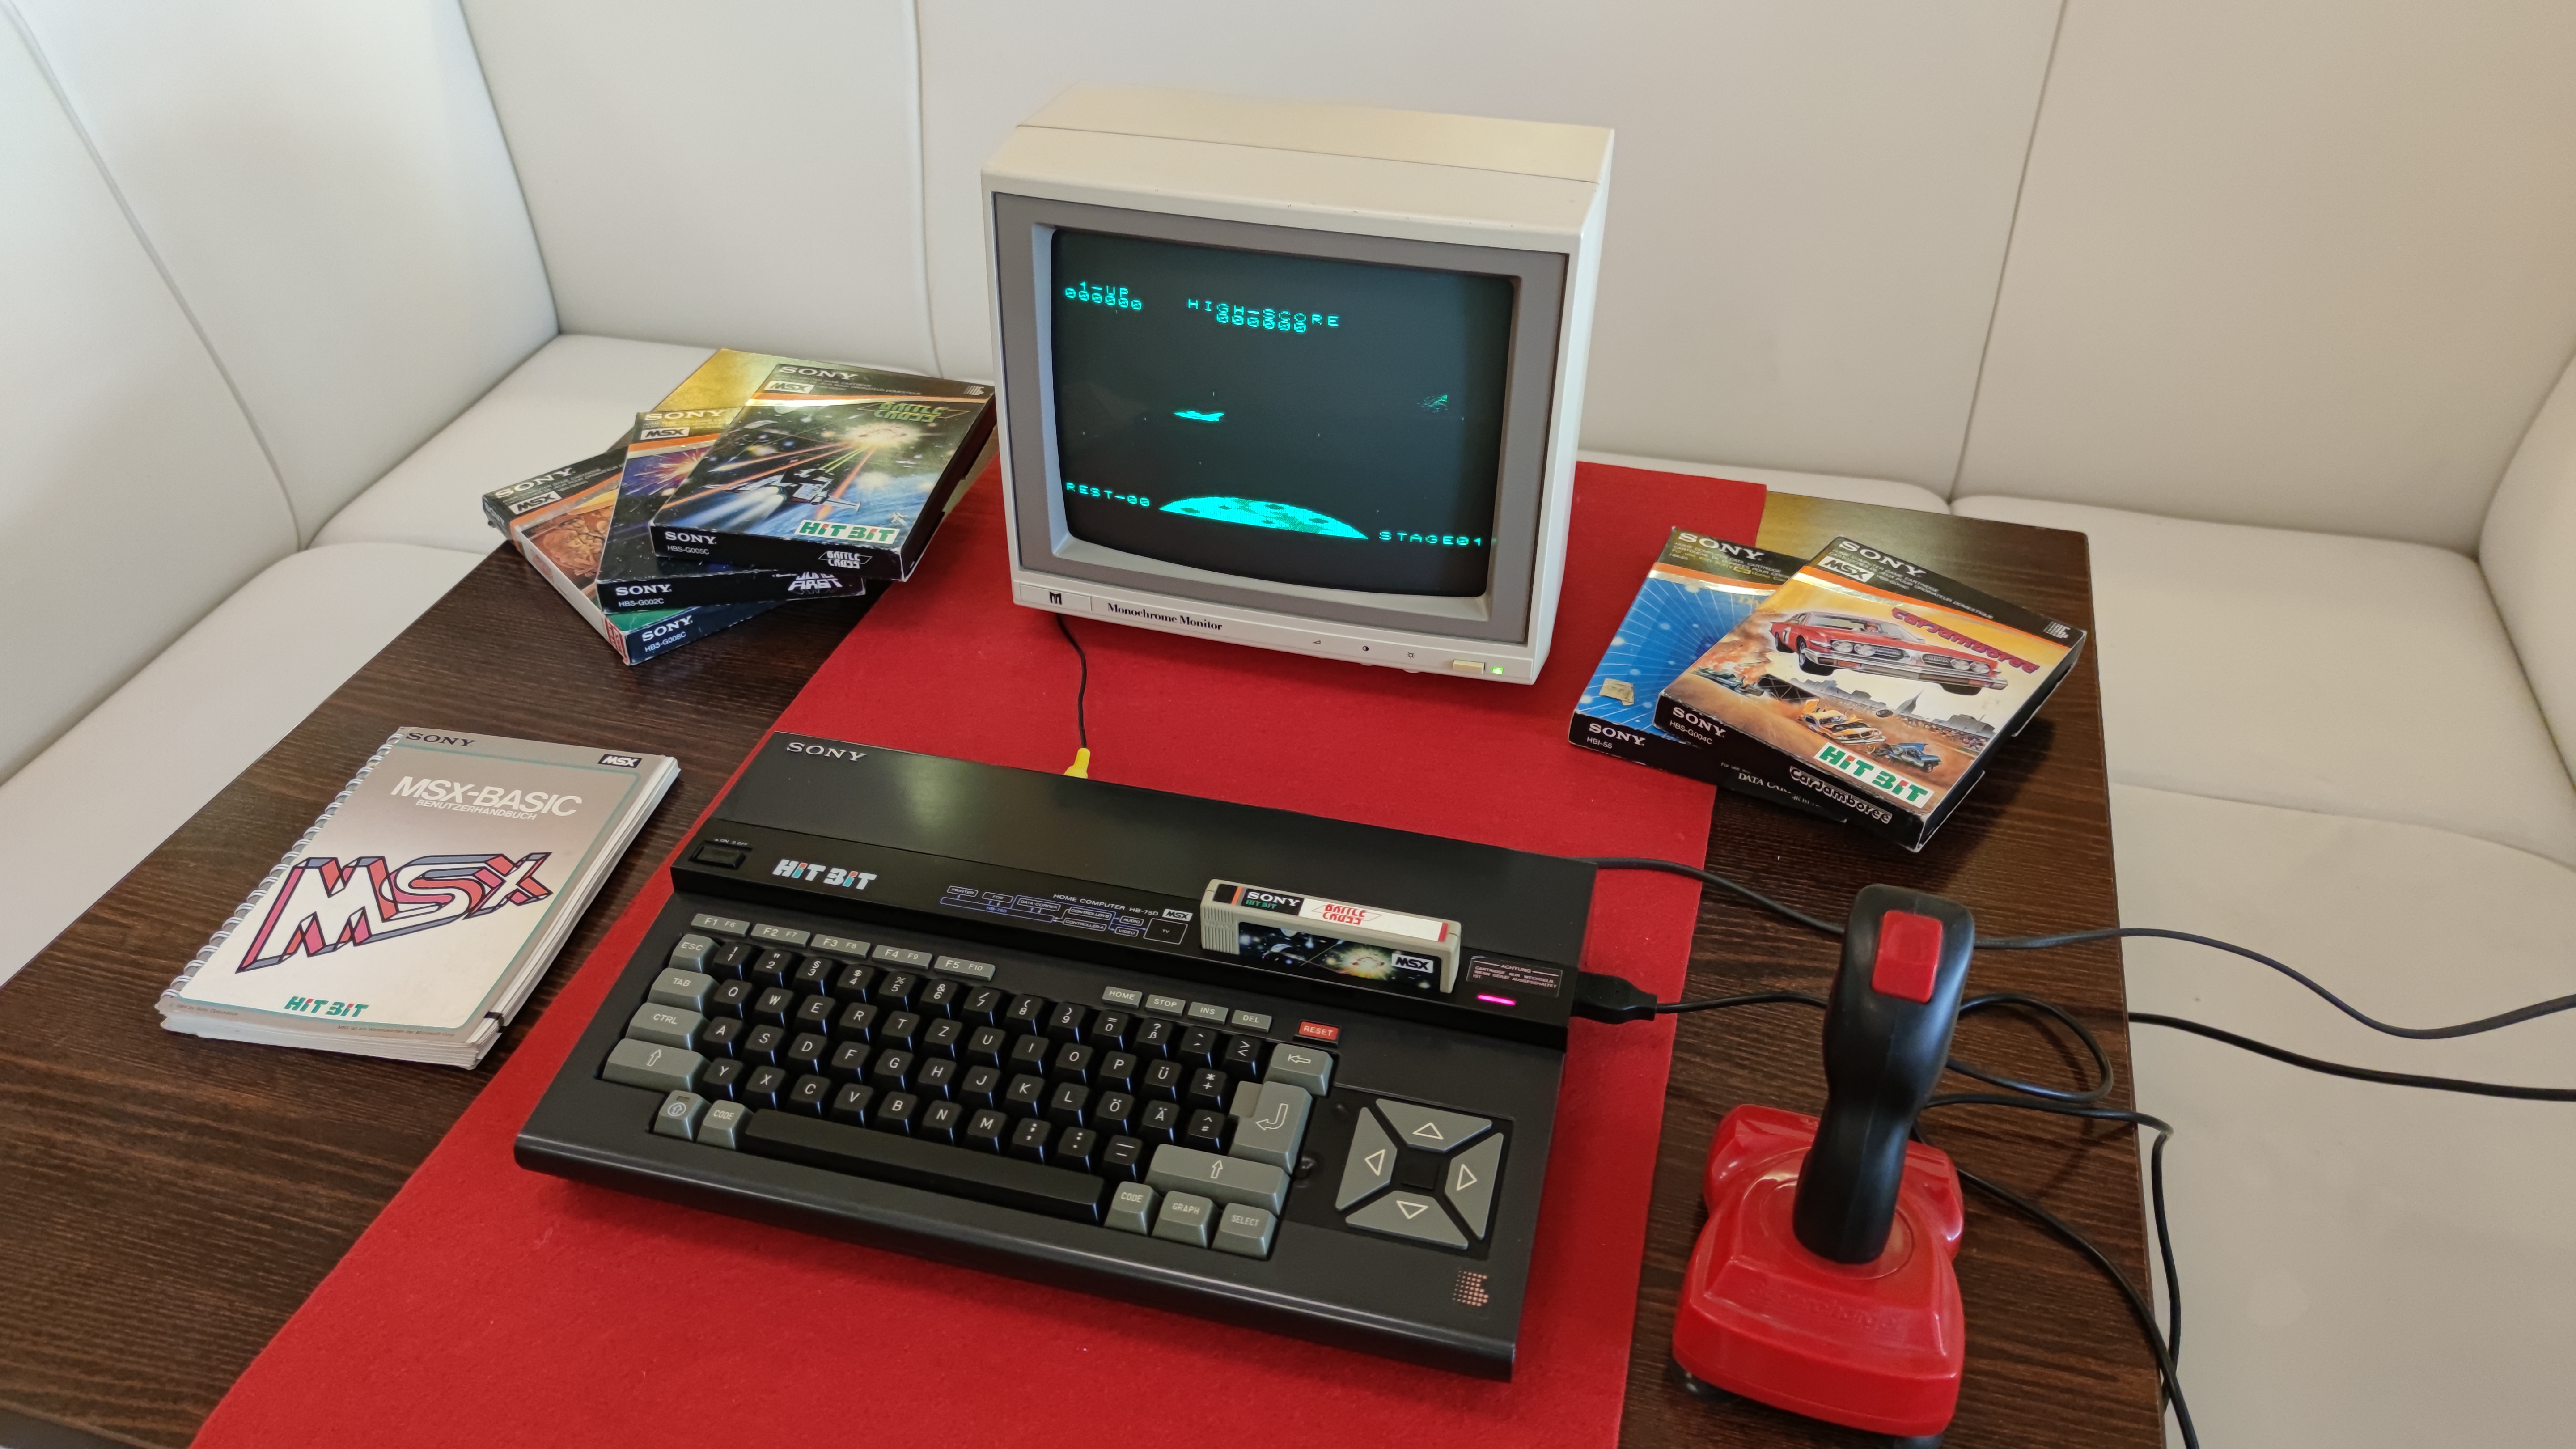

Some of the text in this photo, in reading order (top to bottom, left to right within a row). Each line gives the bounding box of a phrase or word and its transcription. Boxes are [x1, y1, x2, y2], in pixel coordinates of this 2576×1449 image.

[1080, 281, 1128, 297] 1-UP
[1065, 288, 1142, 310] 000000
[1188, 298, 1339, 327] HIGH-SCORE
[1216, 313, 1306, 333] 000000
[779, 366, 858, 380] SONY
[769, 382, 810, 392] MSX
[645, 410, 726, 420] SONY
[645, 429, 685, 438] MSX
[495, 467, 572, 499] SONY
[1066, 482, 1149, 507] REST-00
[517, 494, 556, 512] MSX
[665, 531, 716, 544] SONY
[1379, 531, 1481, 546] STAGE01
[667, 545, 709, 555] HBS-G005C
[1678, 533, 1764, 561] SONY
[1839, 541, 1926, 576] SONY
[1747, 562, 1781, 573] CARTRIDGE
[1824, 560, 1868, 580] MSX
[615, 584, 672, 596] SONY
[788, 578, 843, 591] FIRST
[1904, 576, 1939, 593] CARTRIDGE
[1878, 570, 1895, 579] JEUX
[1895, 576, 1913, 587] POUR
[1914, 584, 1952, 603] ORDINATEUR
[1953, 600, 1993, 620] DOMESTIQUE
[618, 598, 664, 607] HBS-G002C
[1108, 603, 1222, 631] Monochrome Monitor
[642, 615, 693, 642] SONY
[644, 631, 686, 653] HBS-G008C
[1673, 707, 1726, 738] SONY
[1589, 723, 1646, 746] SONY
[1670, 720, 1712, 745] HBS-G004C
[406, 732, 477, 747] SONY
[786, 742, 866, 761] SONY
[602, 756, 637, 767] MSX
[1738, 773, 1764, 786] DATA
[391, 776, 582, 817] MSX-BASIC
[1789, 766, 1892, 824] CarJamboree
[415, 799, 537, 820] BENUTZERHANDBUCH
[1247, 892, 1300, 906] SONY
[1053, 894, 1158, 916] HOME COMPUTER HB-75D
[235, 852, 553, 973] MSX
[1165, 911, 1190, 919] MSX
[704, 918, 717, 927] F1
[763, 928, 778, 936] F2
[681, 941, 703, 952] ESC
[823, 939, 838, 947] F3
[885, 949, 898, 958] F4
[945, 960, 983, 972] F5 F10
[1395, 957, 1429, 970] MSX
[1500, 964, 1531, 973] ACHTUNG
[1475, 966, 1505, 974] CARTRIDGE
[673, 978, 691, 987] TAB
[1512, 978, 1557, 988] AUSGESCHALTET
[728, 987, 738, 997] Q
[1109, 990, 1135, 1000] HOME
[769, 995, 780, 1005] W
[1153, 998, 1177, 1008] STOP
[811, 1003, 822, 1013] E
[1200, 1007, 1216, 1015] INS
[653, 1013, 677, 1024] CTRL
[853, 1011, 864, 1021] R
[1242, 1015, 1259, 1023] DEL
[898, 1019, 907, 1029] T
[716, 1025, 725, 1036] A
[939, 1027, 949, 1037] Z
[1303, 1025, 1334, 1036] RESET
[759, 1034, 770, 1043] S
[983, 1035, 993, 1045] U
[801, 1042, 813, 1052] D
[1028, 1043, 1034, 1053] I
[844, 1050, 857, 1060] F
[1069, 1052, 1080, 1062] O
[889, 1058, 900, 1068] G
[1114, 1059, 1124, 1069] P
[931, 1067, 944, 1077] H
[1158, 1067, 1169, 1080] Ü
[713, 1110, 735, 1120] CODE
[1120, 1192, 1142, 1203] CODE
[1172, 1202, 1200, 1216] GRAPH
[1231, 1214, 1259, 1227] SELECT
